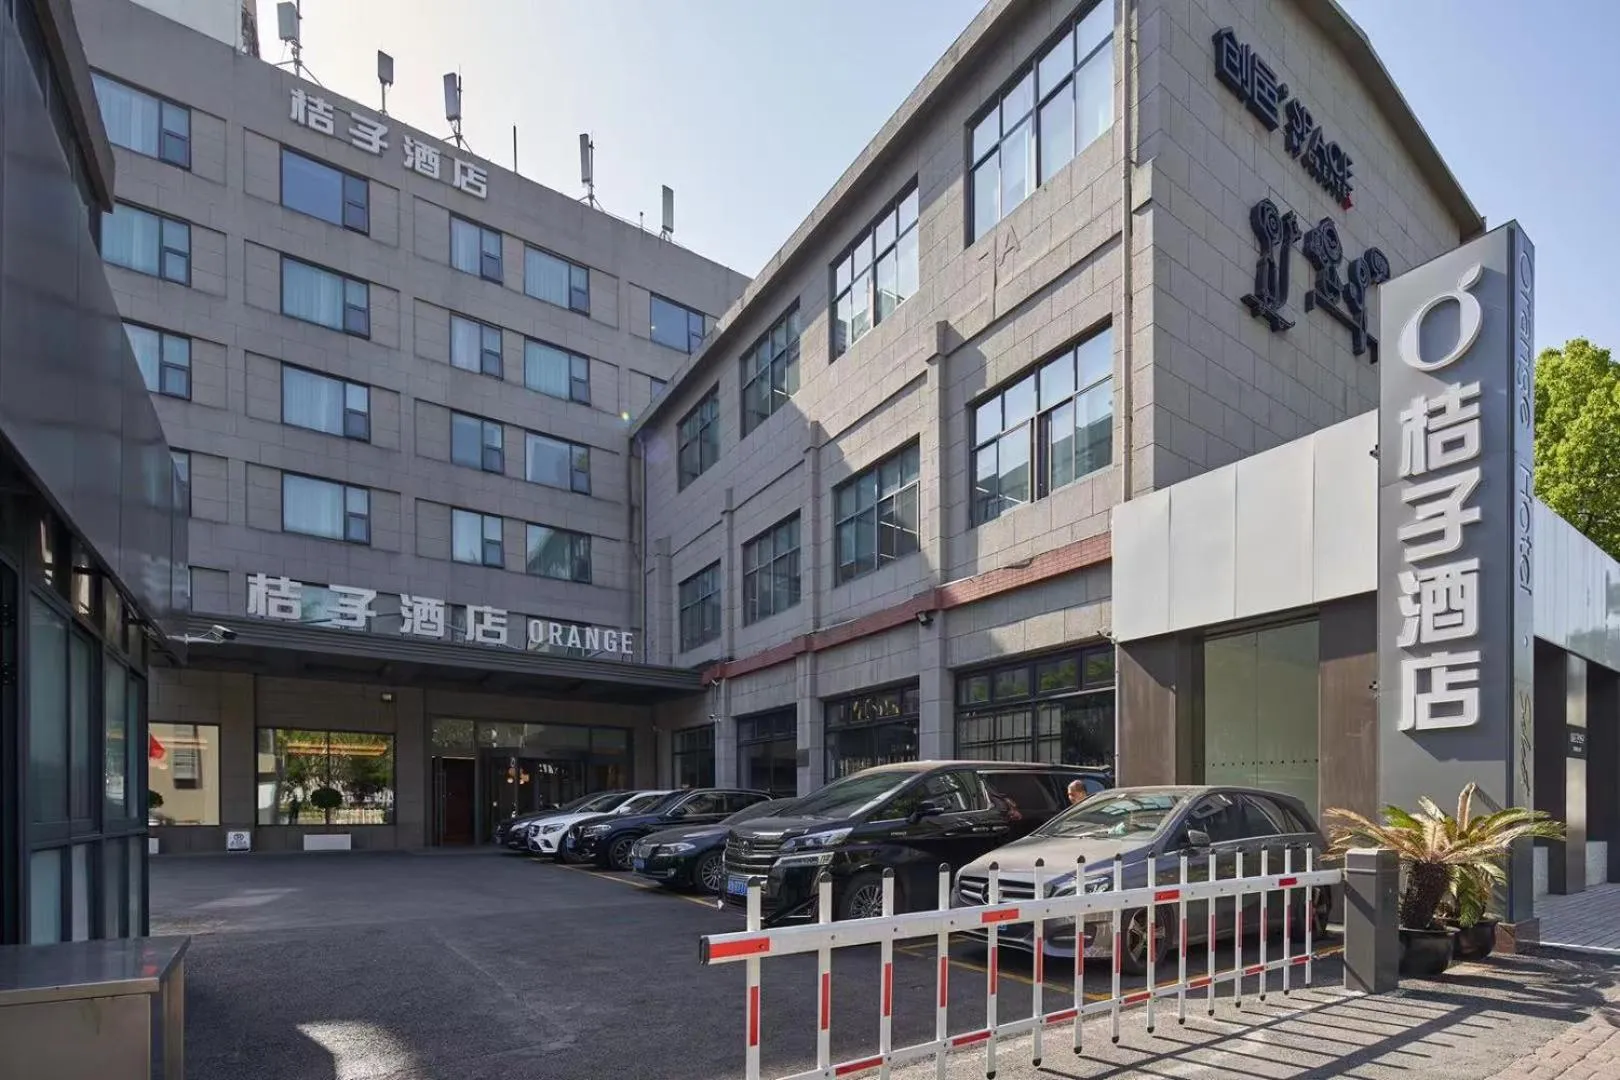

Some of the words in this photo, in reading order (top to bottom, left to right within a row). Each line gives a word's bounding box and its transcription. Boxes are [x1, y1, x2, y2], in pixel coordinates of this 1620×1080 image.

[290, 88, 488, 200] 桔子酒店
[1519, 250, 1533, 429] Orange
[1397, 380, 1482, 732] 桔子酒店
[1519, 463, 1533, 597] Hotel
[246, 572, 508, 645] 桔子酒店
[528, 619, 634, 655] ORANGE
